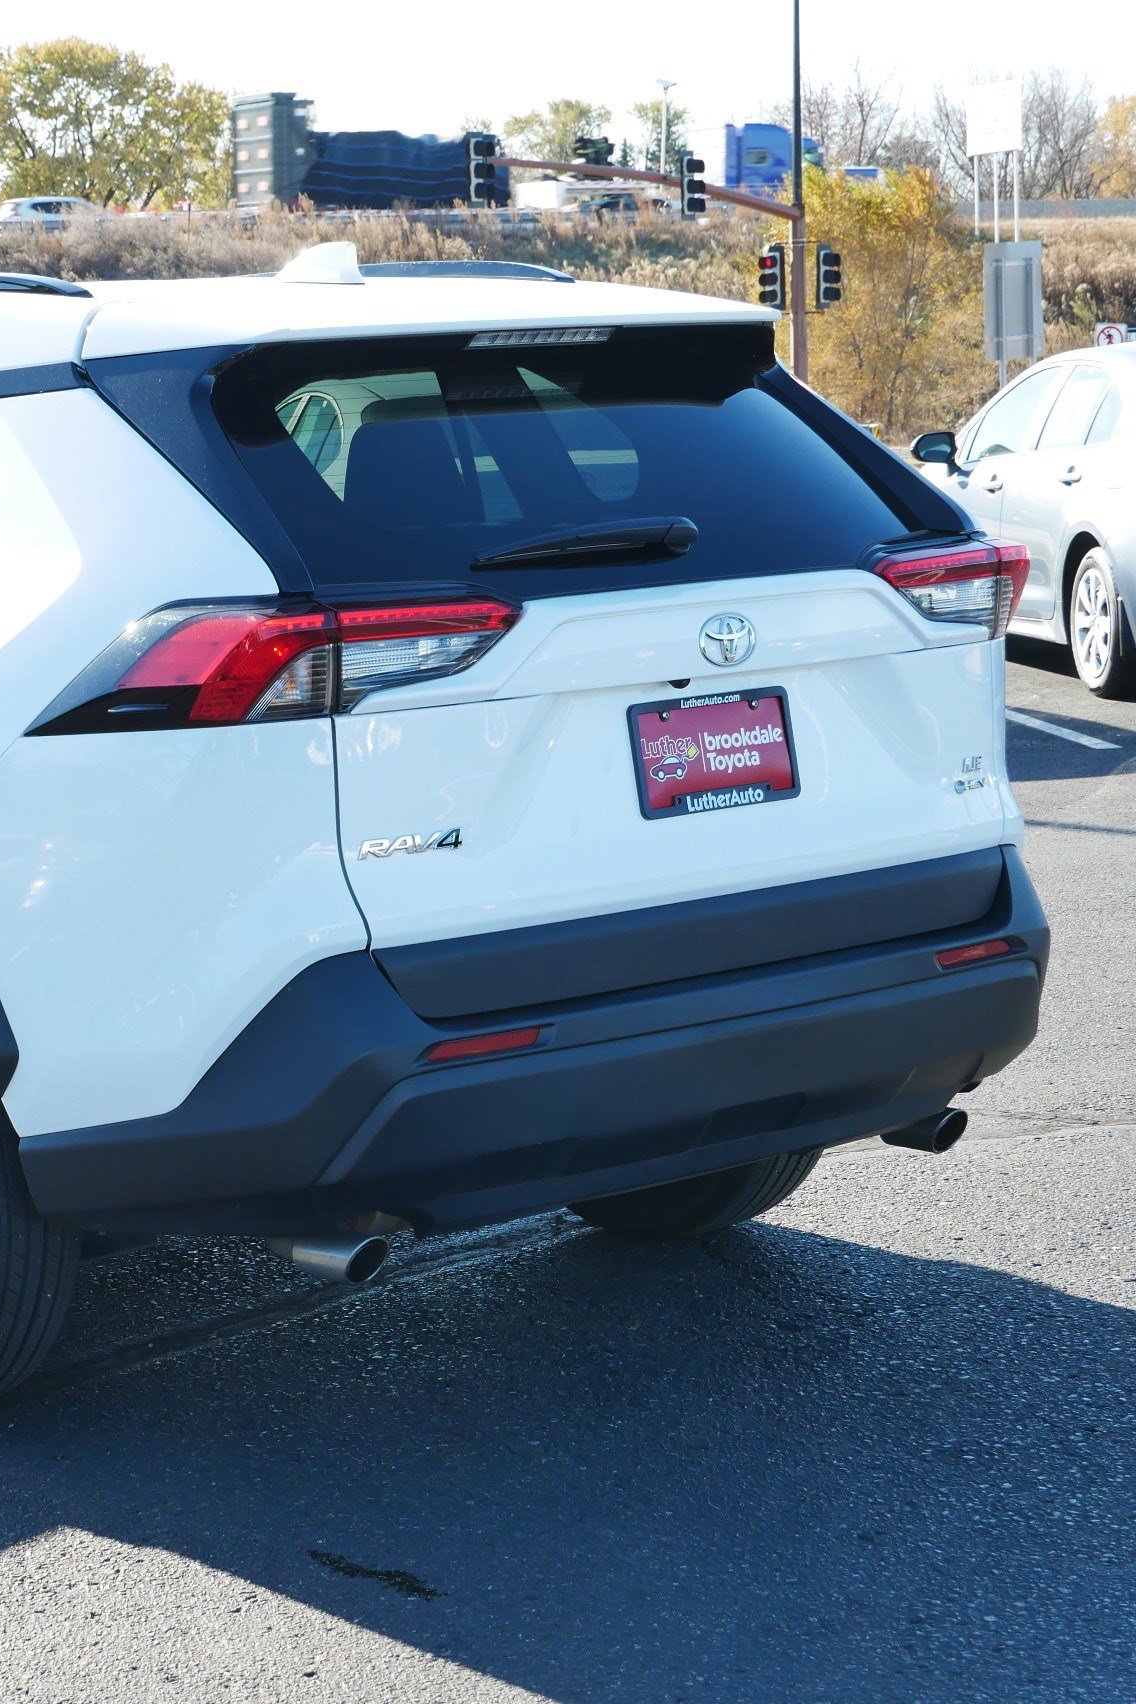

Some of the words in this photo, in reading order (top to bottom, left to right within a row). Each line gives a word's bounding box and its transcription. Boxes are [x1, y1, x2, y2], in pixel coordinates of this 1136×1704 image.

[680, 693, 740, 709] LutherAuto.com
[641, 735, 693, 760] Luther
[703, 724, 784, 751] brookdale
[707, 749, 761, 774] Toyota
[961, 755, 982, 774] LE
[686, 786, 764, 812] LutherAuto
[358, 827, 463, 861] RAV4
